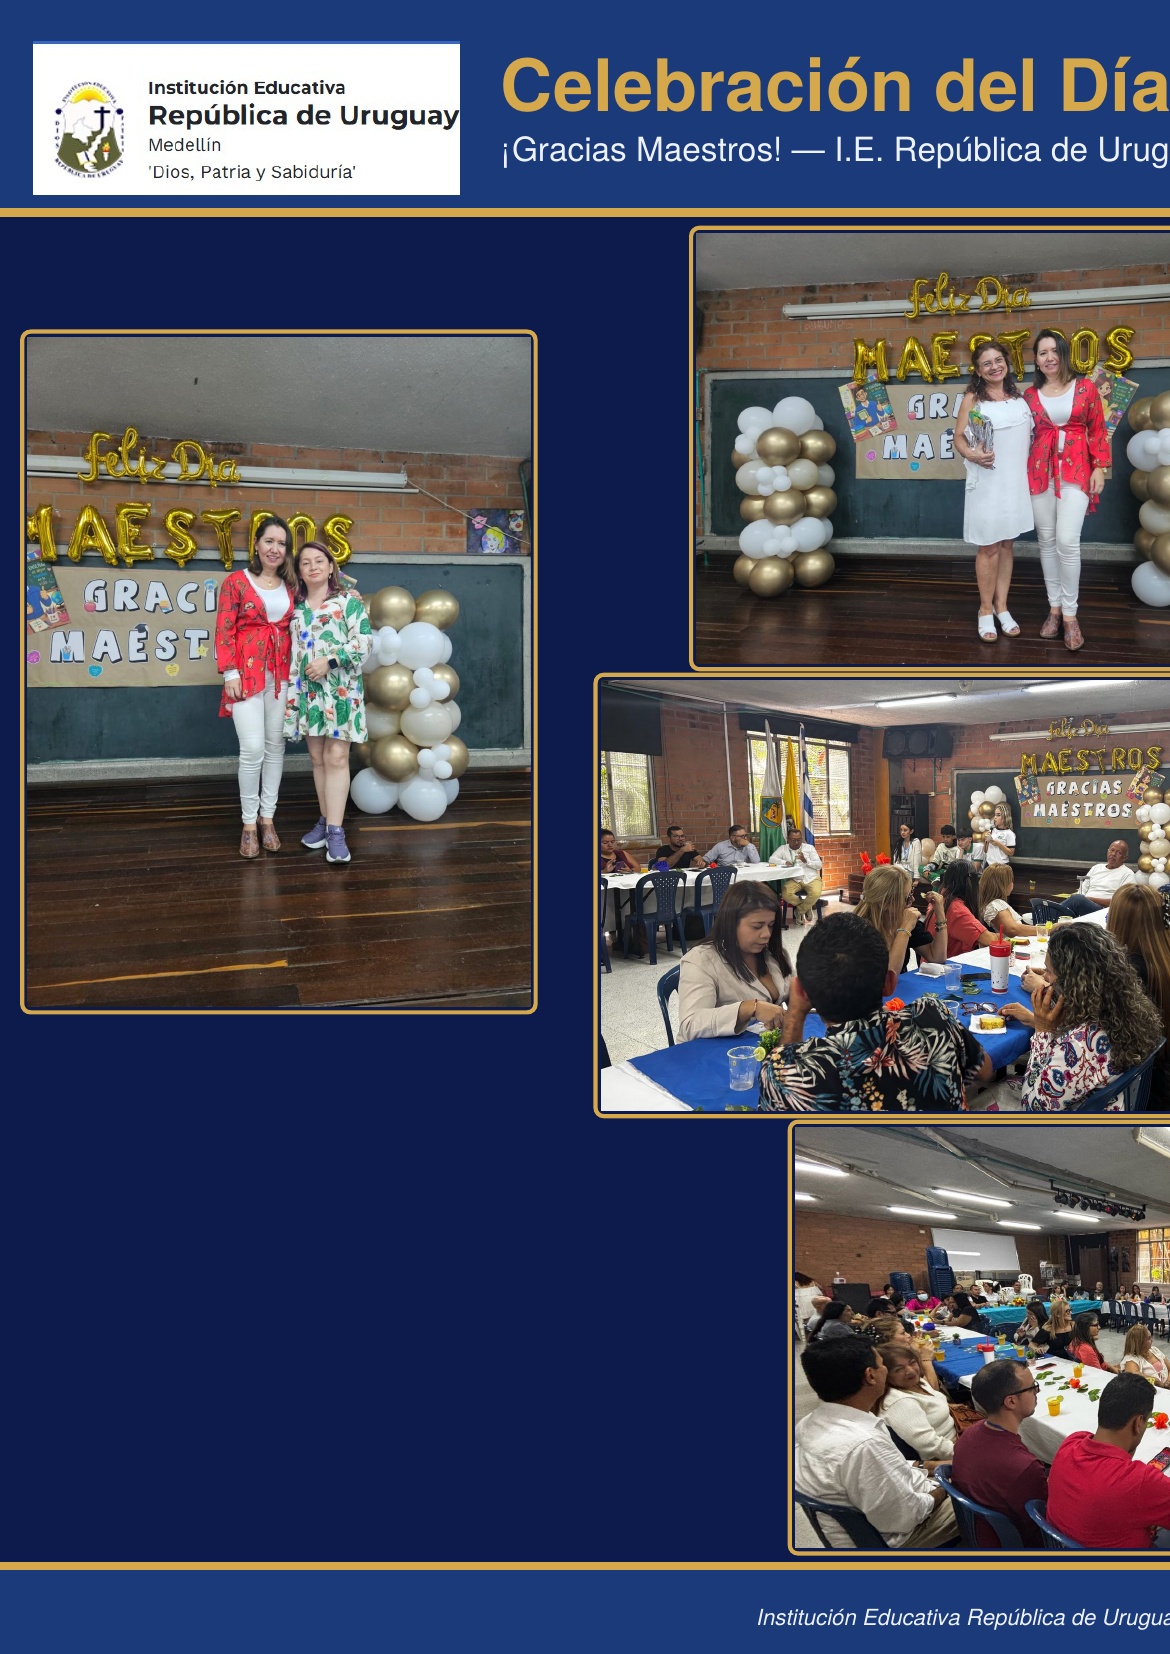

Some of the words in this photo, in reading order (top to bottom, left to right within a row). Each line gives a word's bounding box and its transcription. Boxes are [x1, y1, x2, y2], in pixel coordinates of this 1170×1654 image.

[83, 578, 219, 614] GRACI
[1020, 746, 1162, 776] MAESTROS
[1046, 779, 1123, 796] GRACIAS
[1033, 802, 1133, 819] MAESTROS
